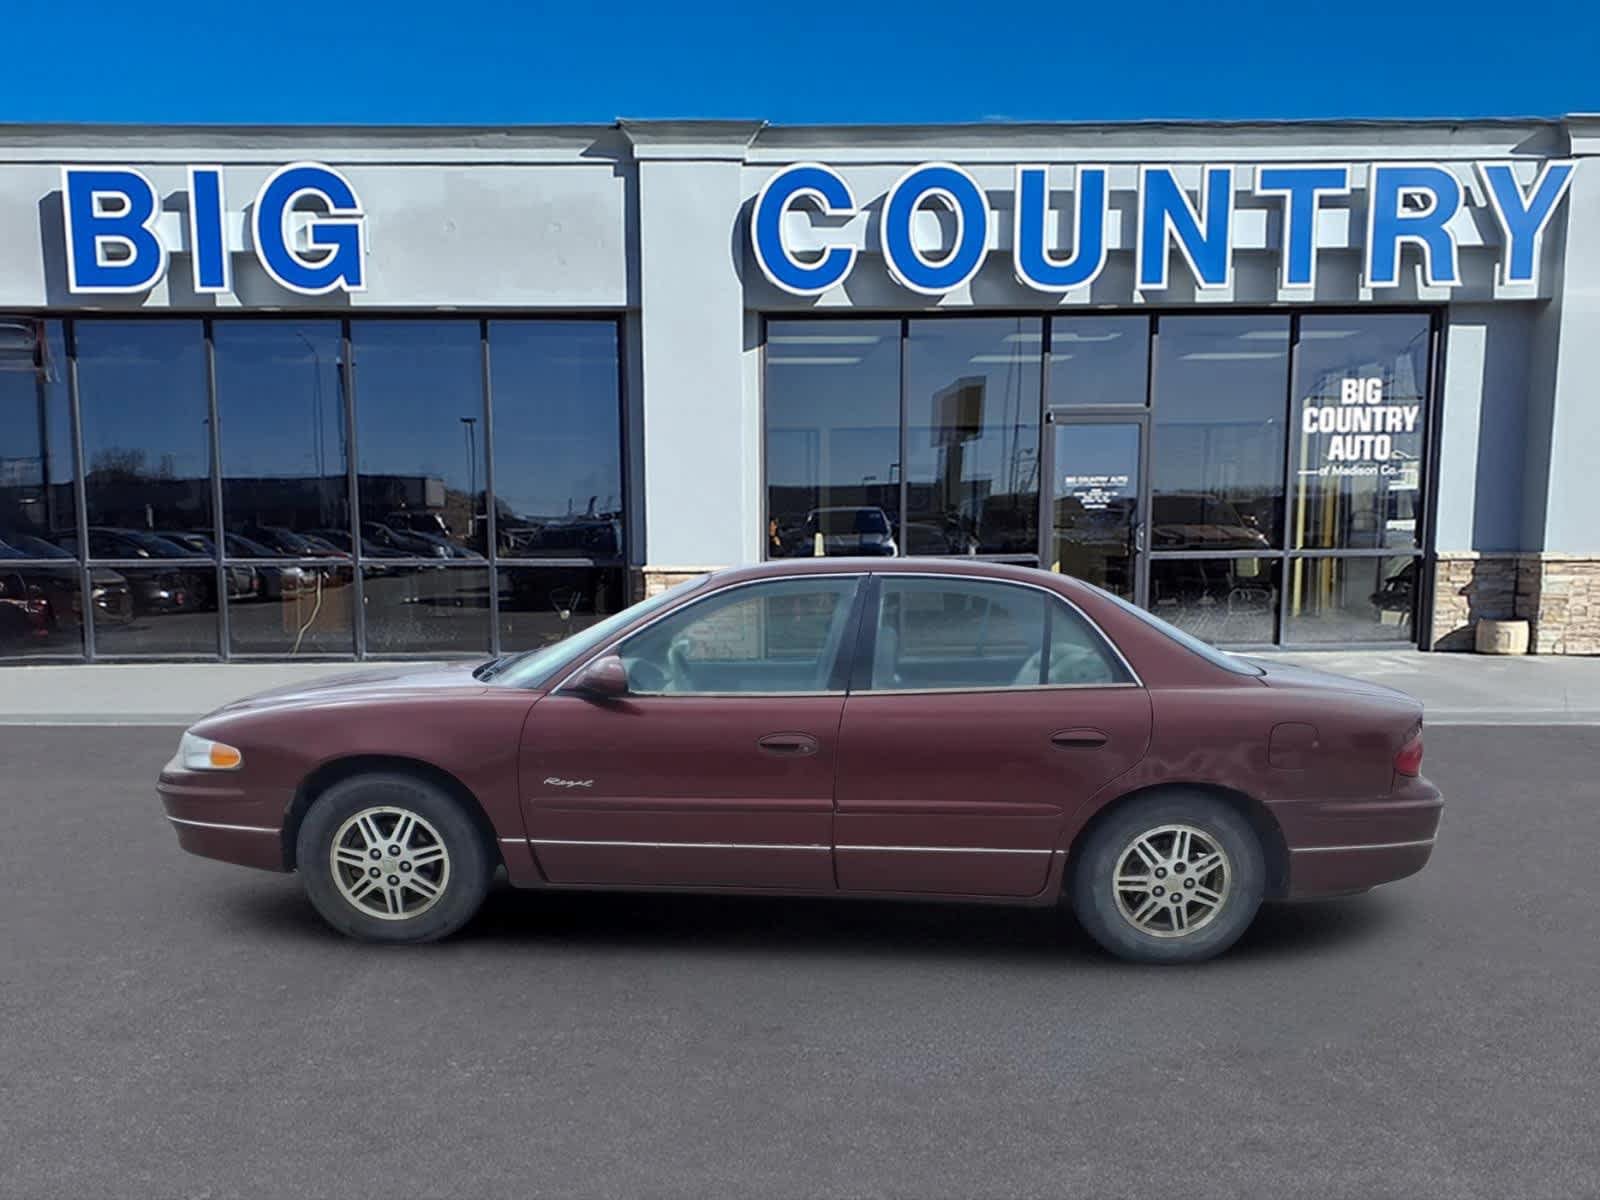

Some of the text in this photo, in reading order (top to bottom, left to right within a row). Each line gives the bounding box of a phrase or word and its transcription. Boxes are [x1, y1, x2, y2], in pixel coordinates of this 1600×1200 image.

[61, 161, 1574, 301] BIG COUNTRY
[1341, 377, 1382, 405] BIG
[1302, 406, 1418, 432] COUNTRY
[1327, 435, 1391, 461] AUTO
[1331, 465, 1378, 476] Madison
